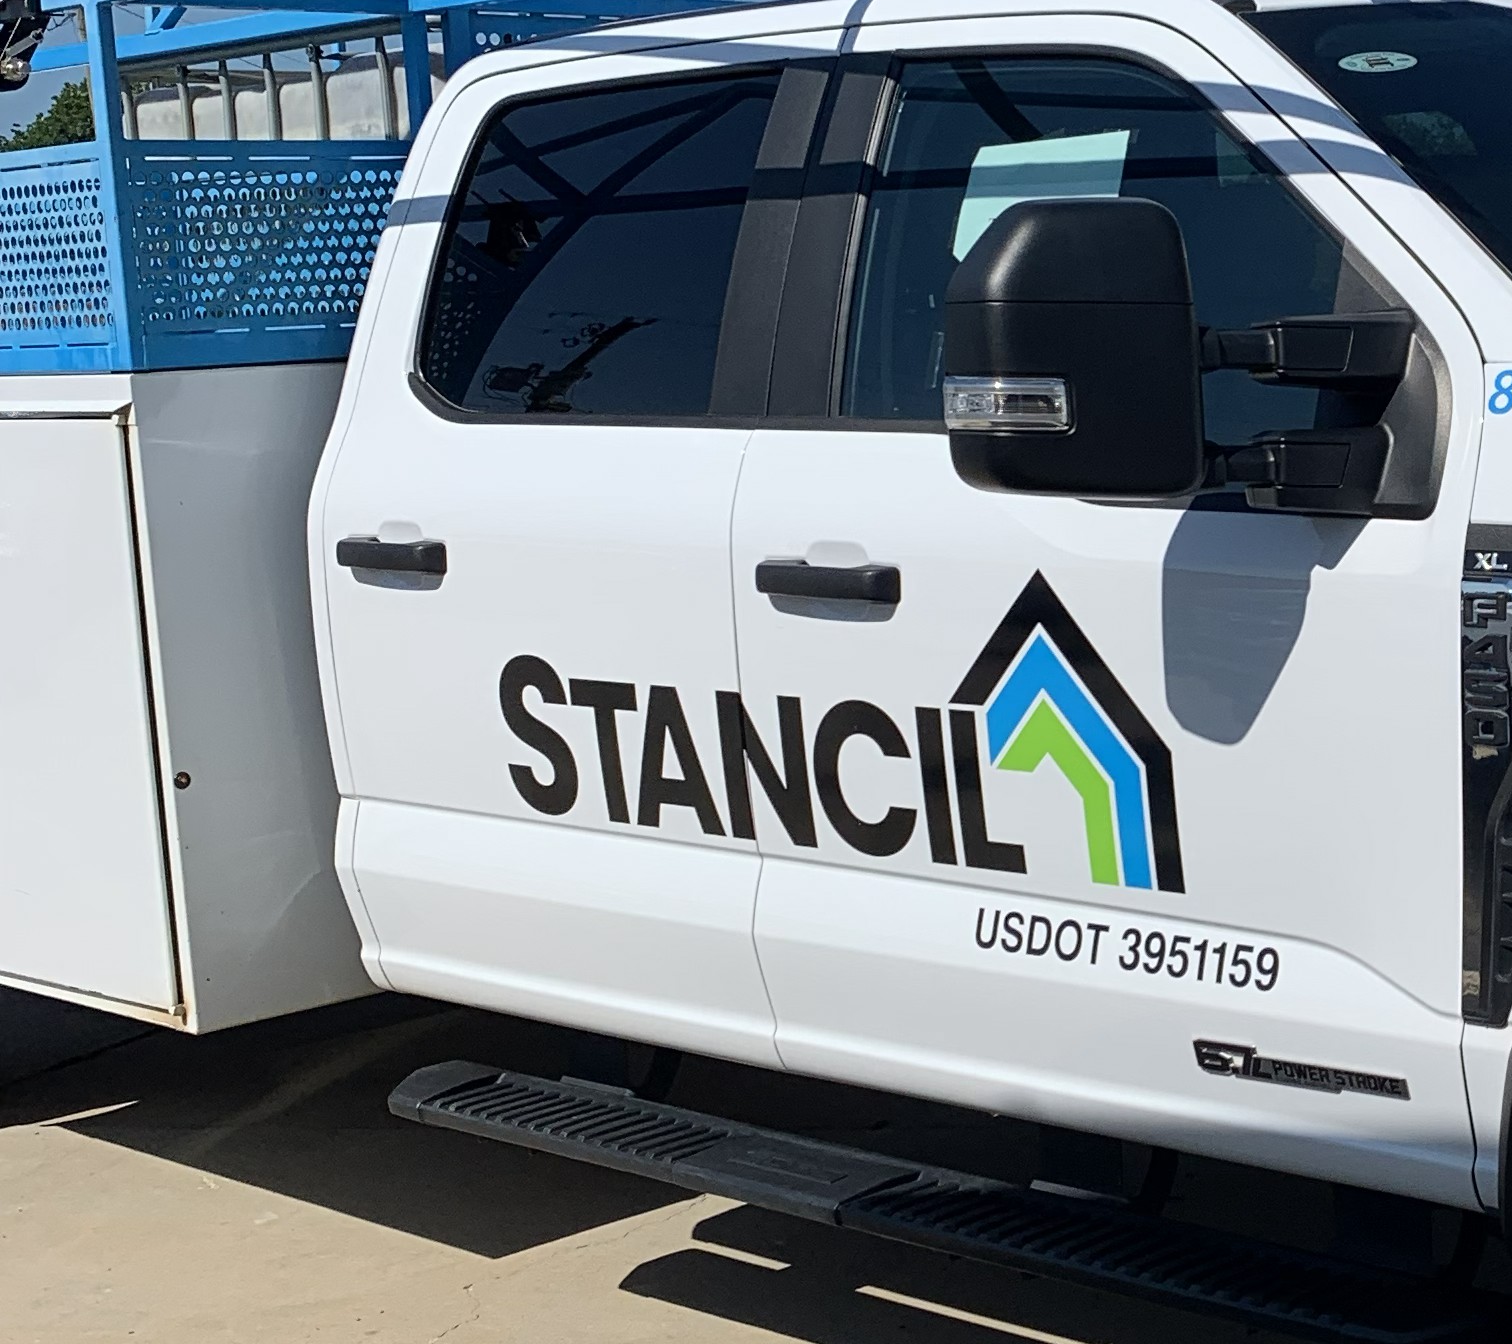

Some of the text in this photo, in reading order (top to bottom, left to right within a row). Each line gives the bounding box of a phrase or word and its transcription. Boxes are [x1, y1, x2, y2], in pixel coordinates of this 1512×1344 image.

[1474, 552, 1509, 571] XL
[499, 654, 1028, 875] STANCIL
[975, 907, 1281, 992] USDOT 3951159
[1273, 1060, 1331, 1084] POWER
[1335, 1070, 1402, 1096] STROKE
